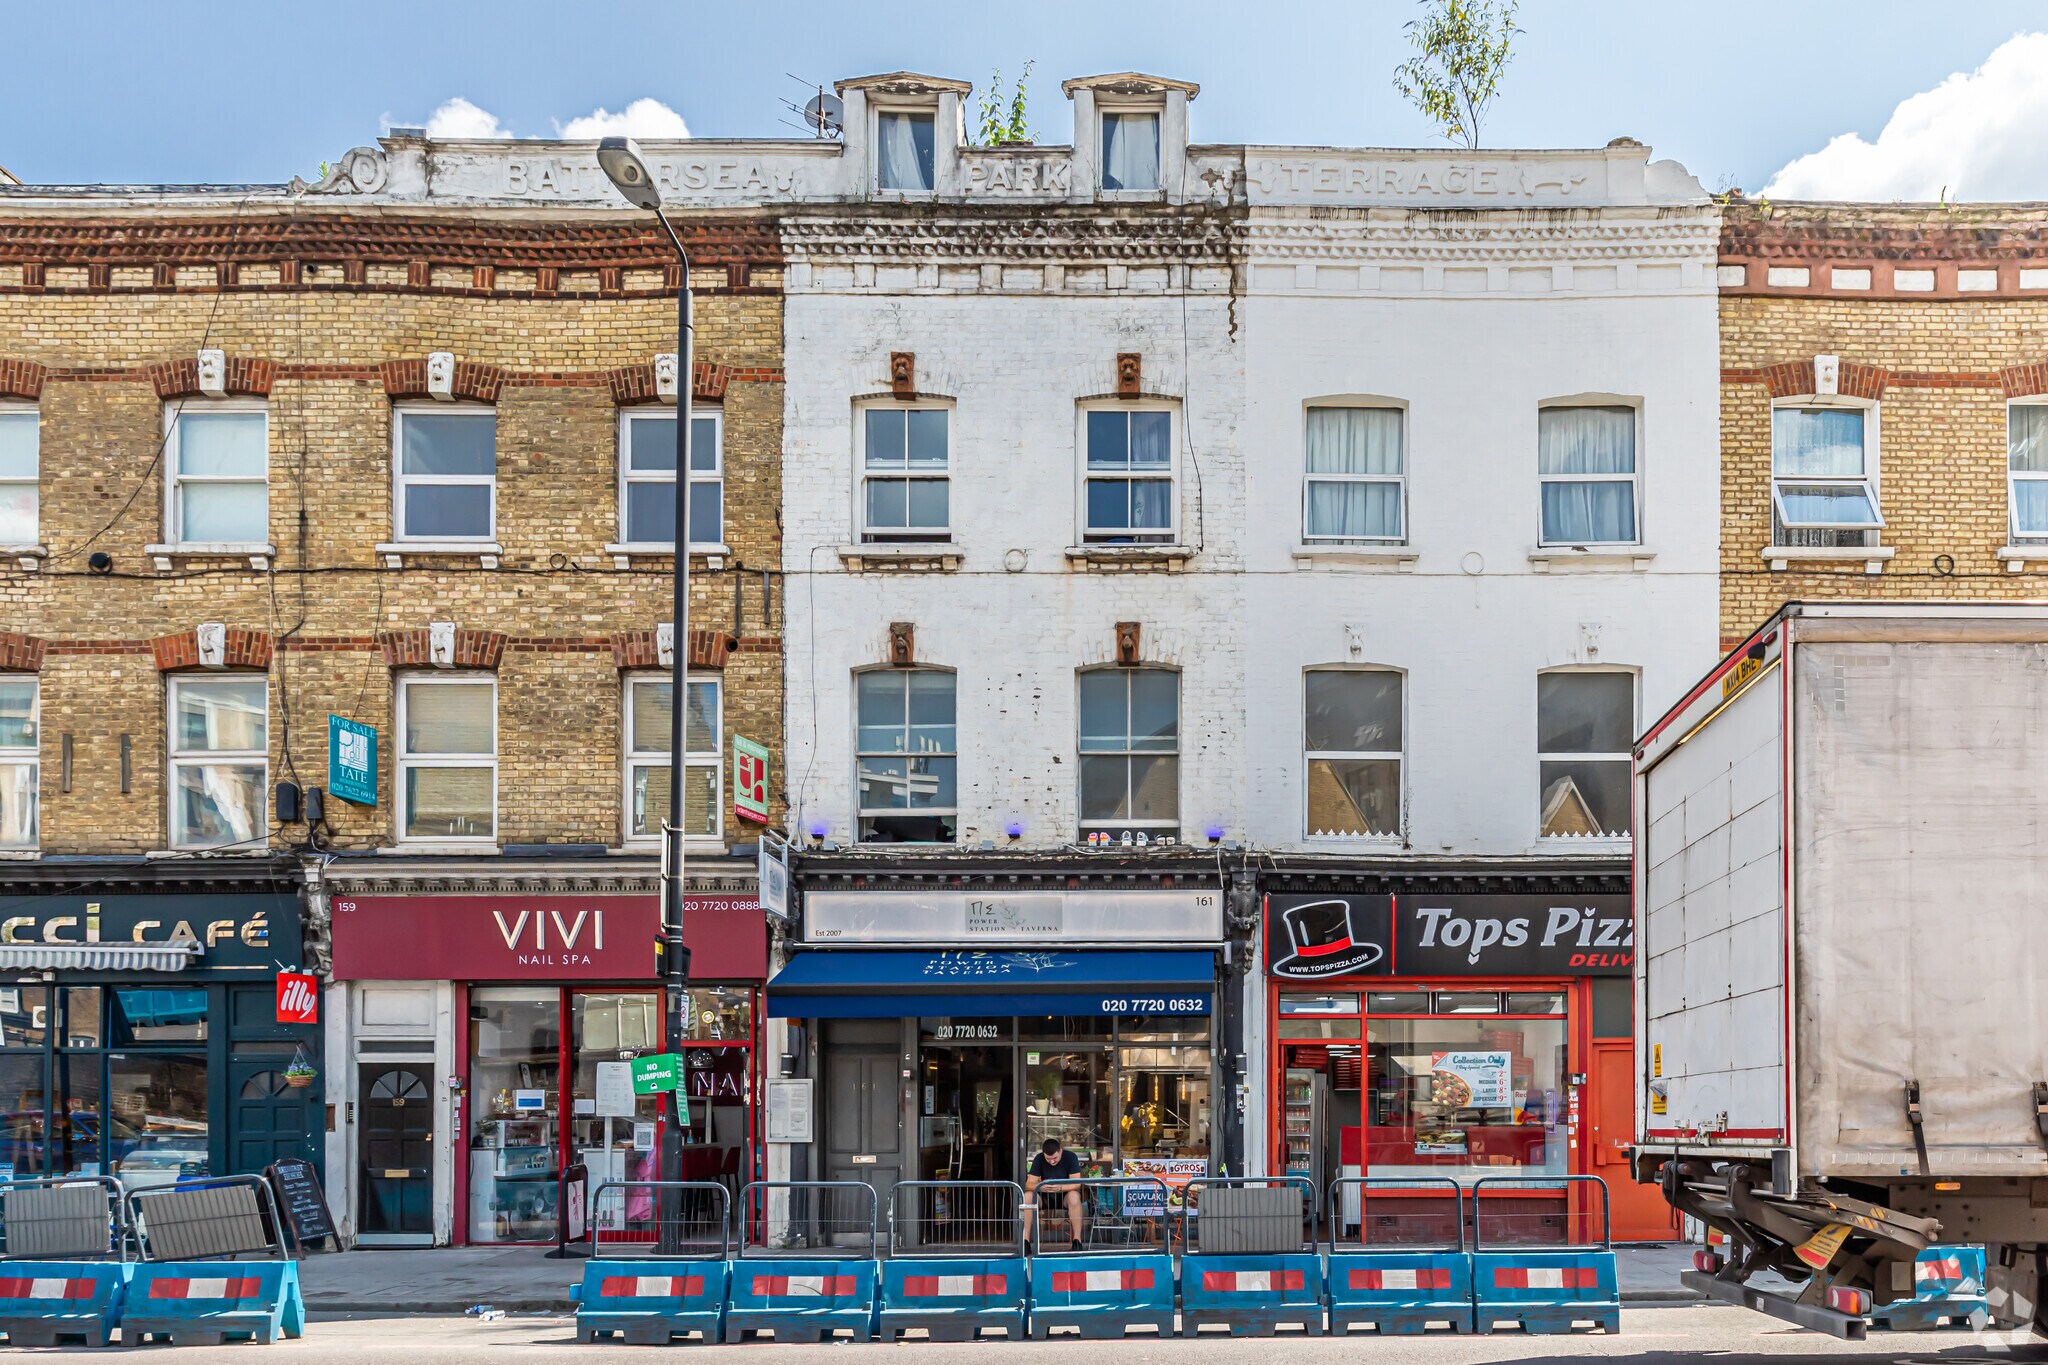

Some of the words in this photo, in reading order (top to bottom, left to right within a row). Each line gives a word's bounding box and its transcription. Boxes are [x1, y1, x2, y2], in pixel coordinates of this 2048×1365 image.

[964, 163, 1068, 191] PARK
[1281, 164, 1500, 195] TERRACE
[332, 716, 350, 731] FOR
[352, 723, 376, 739] SALE
[340, 765, 368, 784] TATE
[331, 782, 344, 792] 020
[338, 902, 356, 912] 159
[682, 901, 699, 911] 20
[702, 901, 729, 911] 7720
[731, 901, 760, 911] 0888
[1195, 896, 1213, 907] 161
[492, 910, 603, 951] VIVI
[815, 929, 825, 937] Est
[826, 929, 842, 937] 2007
[1415, 907, 1530, 966] Tops
[518, 954, 554, 965] NAIL
[562, 954, 591, 965] SPA
[1288, 953, 1369, 973] WWW.TOPSPIZZA.COM
[280, 980, 315, 1019] illy
[1102, 1000, 1127, 1012] 020
[1131, 999, 1165, 1012] 7720
[1169, 999, 1203, 1011] 0632
[937, 1025, 953, 1038] 020
[955, 1025, 976, 1038] 7720
[977, 1025, 998, 1038] 0632
[646, 1063, 658, 1072] NO
[1452, 1055, 1487, 1064] Collection
[1487, 1054, 1506, 1068] Only
[637, 1070, 672, 1082] DUMPING
[1174, 1163, 1201, 1173] GYROS
[1127, 1191, 1164, 1202] SOUVLAKI
